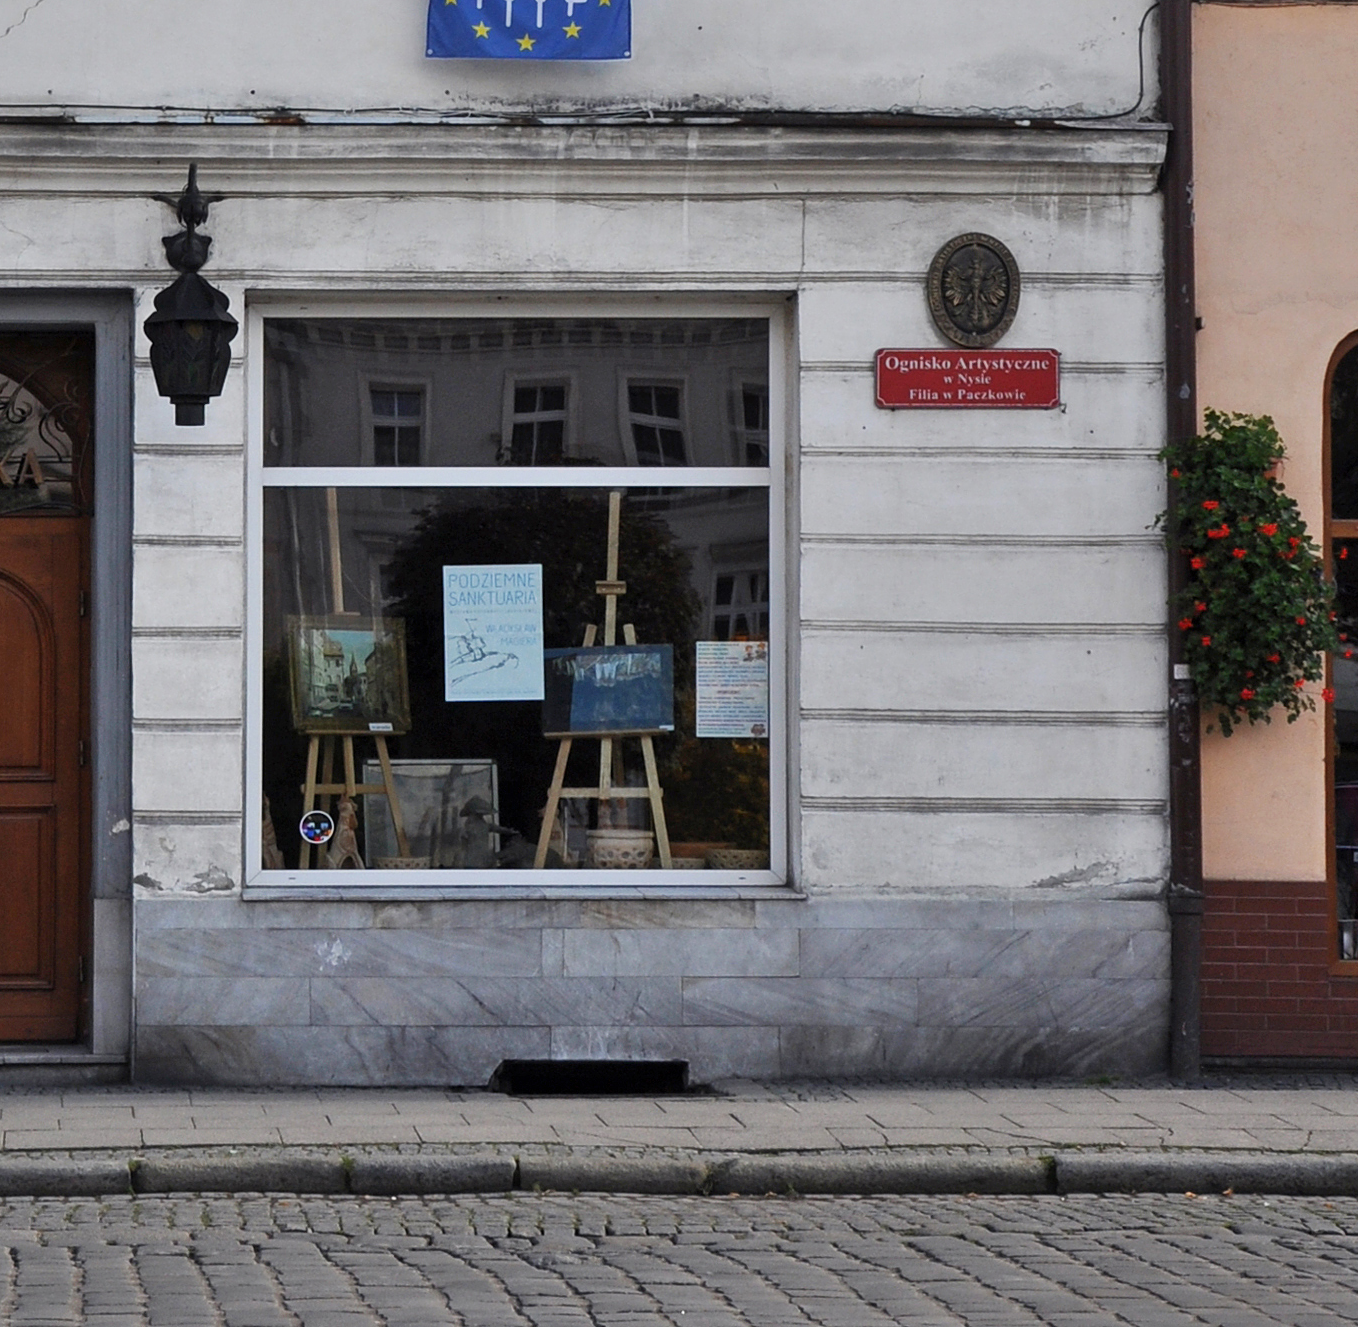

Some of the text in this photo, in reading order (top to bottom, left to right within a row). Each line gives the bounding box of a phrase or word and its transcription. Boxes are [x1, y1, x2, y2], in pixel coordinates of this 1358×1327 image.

[885, 356, 1050, 374] Ognisko Artystyczne
[944, 373, 991, 387] w Nysie
[909, 389, 1026, 400] Filia w Paczkowie
[448, 573, 535, 588] PODZIEMNE
[449, 590, 536, 606] SANKTUARIA
